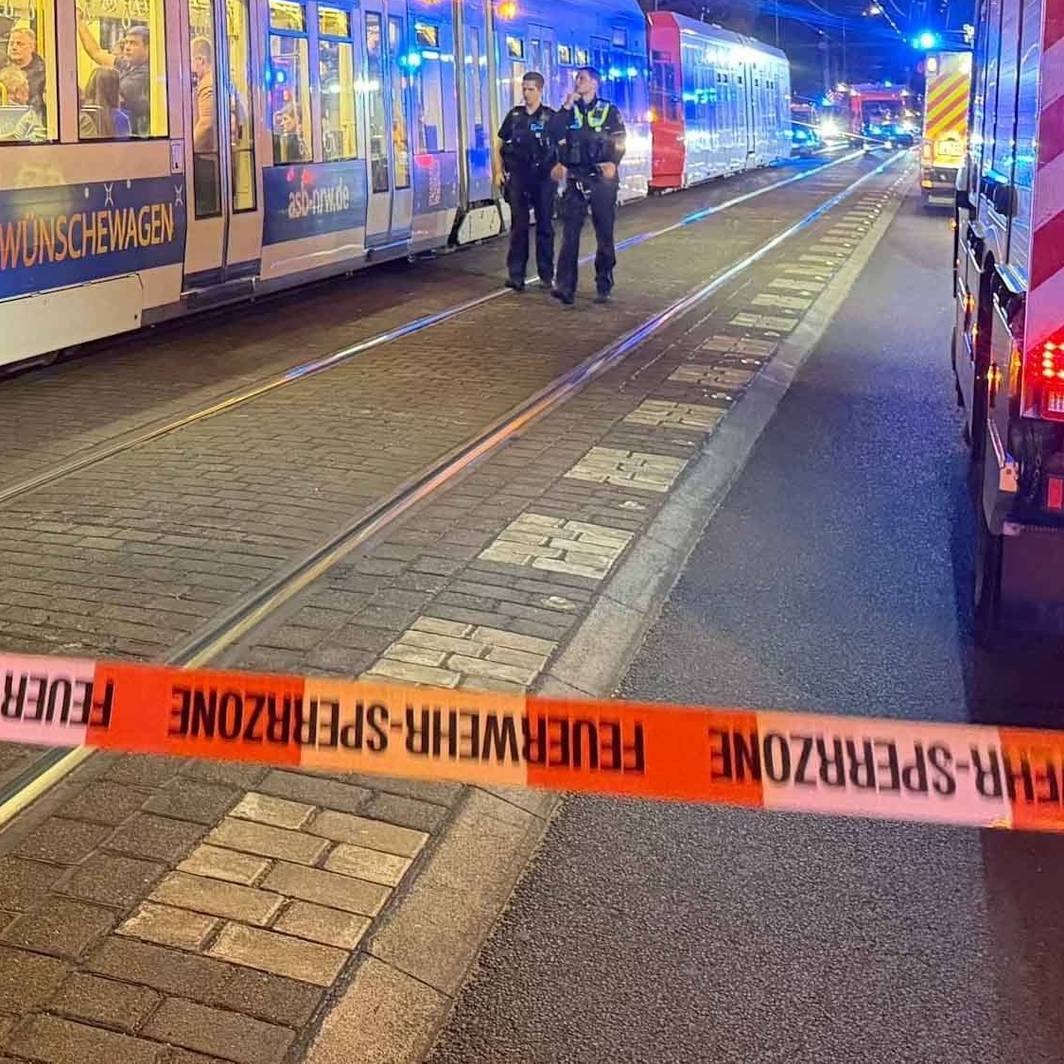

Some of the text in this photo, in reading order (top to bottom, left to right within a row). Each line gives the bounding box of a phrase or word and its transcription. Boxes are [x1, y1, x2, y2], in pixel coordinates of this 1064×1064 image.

[288, 177, 349, 219] asb-nrw.de
[170, 685, 645, 775] FEUERWEHR-SPERRZONE
[709, 726, 1064, 802] EHR-SPERRZONE
